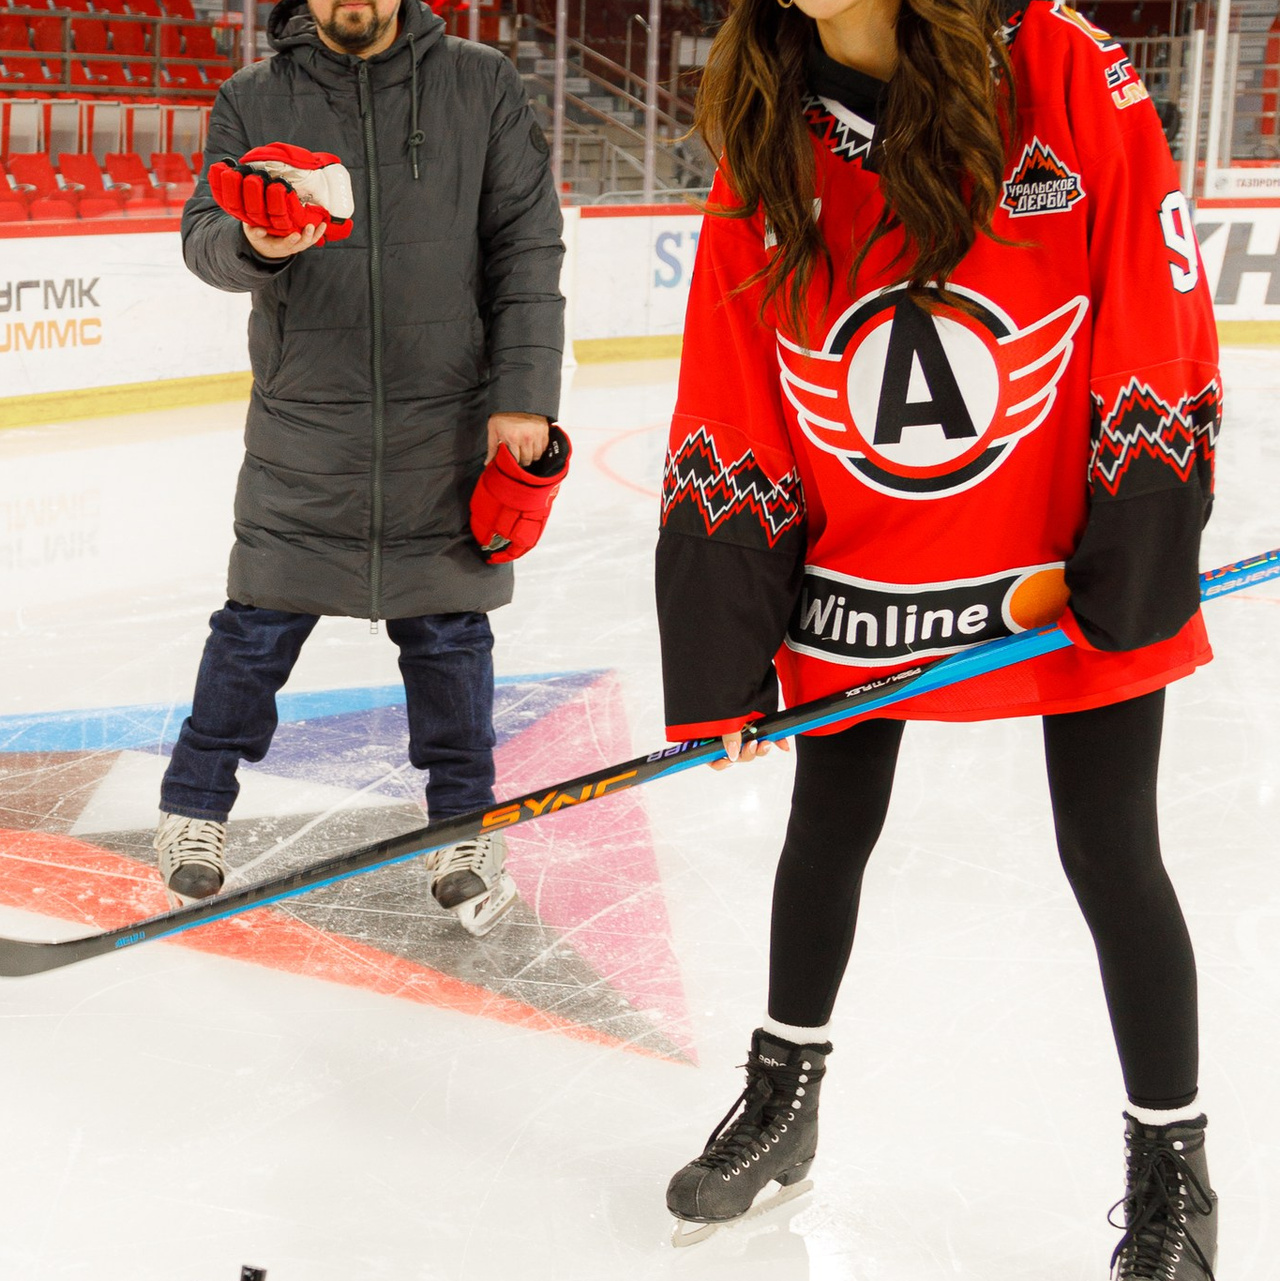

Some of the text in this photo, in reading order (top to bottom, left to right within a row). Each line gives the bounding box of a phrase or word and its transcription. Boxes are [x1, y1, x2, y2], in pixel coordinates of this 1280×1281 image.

[1008, 177, 1075, 198] УРАЛЬСКОЕ
[1015, 190, 1067, 212] ДЕРБИ
[800, 587, 989, 648] Winline
[479, 769, 638, 835] SYNC
